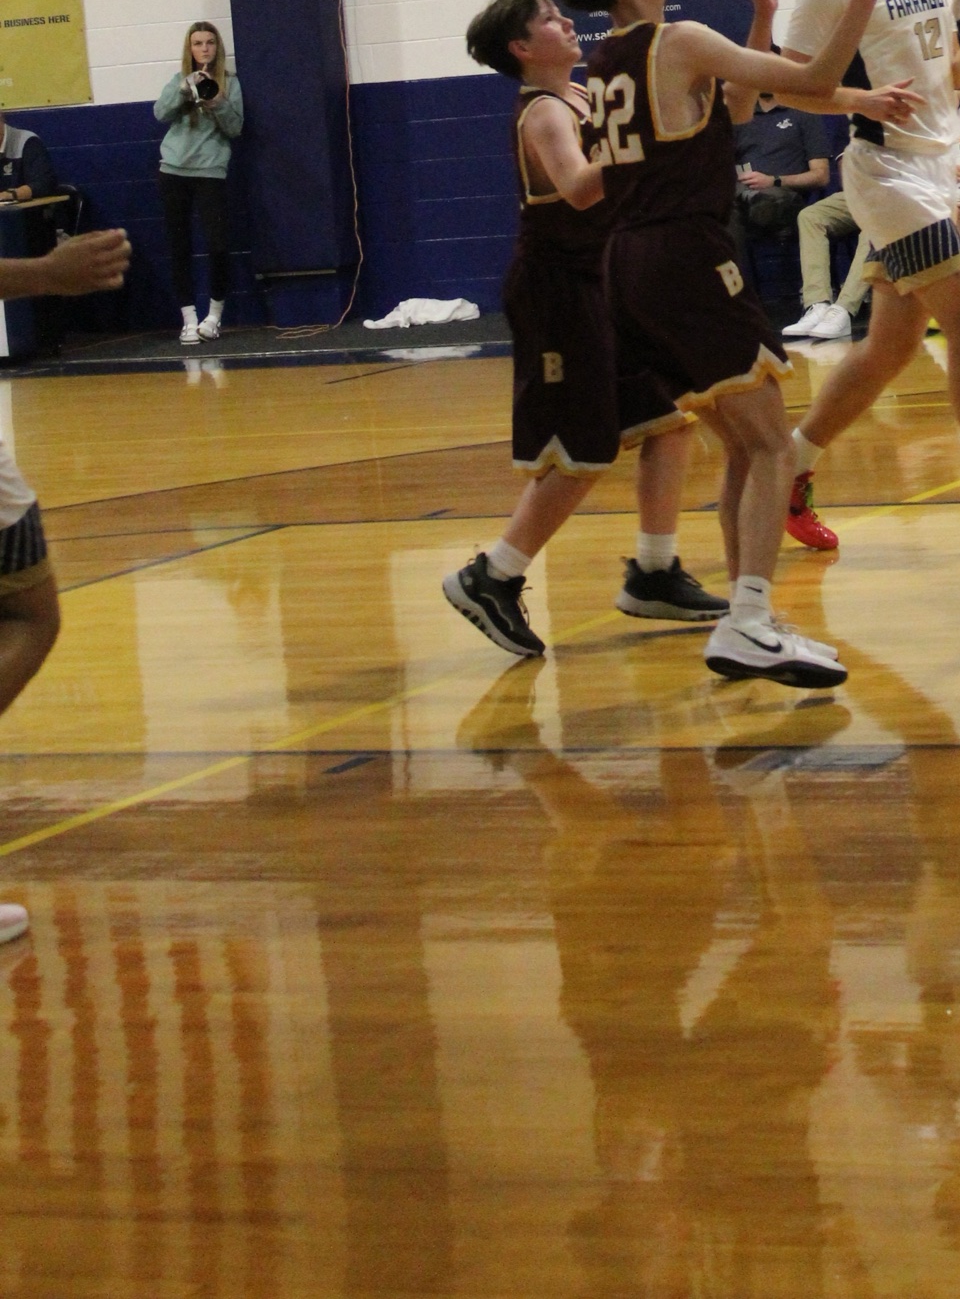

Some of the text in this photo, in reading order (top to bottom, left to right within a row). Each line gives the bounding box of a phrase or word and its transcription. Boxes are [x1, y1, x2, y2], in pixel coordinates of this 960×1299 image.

[4, 14, 71, 28] BUSINESS HERE
[914, 17, 944, 61] 12
[715, 260, 744, 297] B
[543, 352, 564, 383] B
